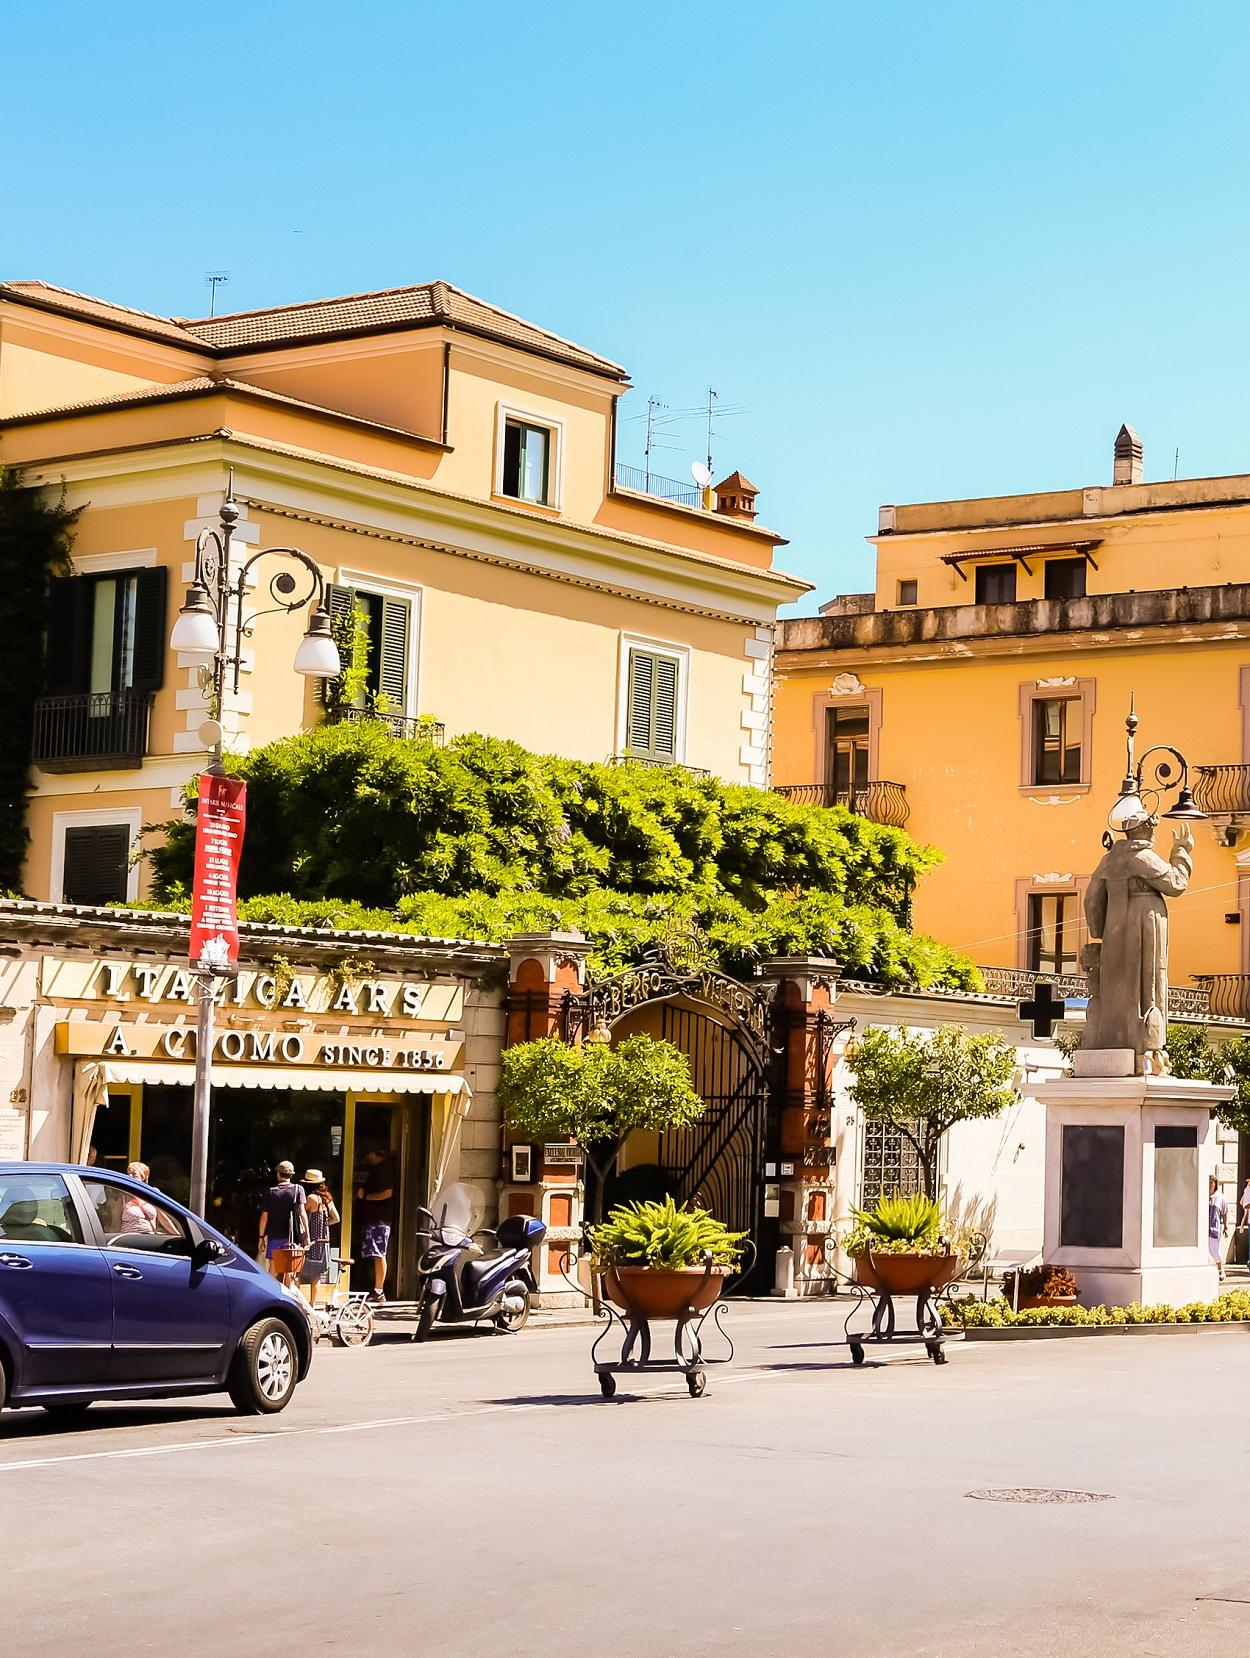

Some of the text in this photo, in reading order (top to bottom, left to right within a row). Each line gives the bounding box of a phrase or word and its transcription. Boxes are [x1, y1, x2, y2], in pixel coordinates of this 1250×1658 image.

[333, 983, 423, 1016] ARS
[105, 1025, 447, 1071] A. COMO SINCE 1856
